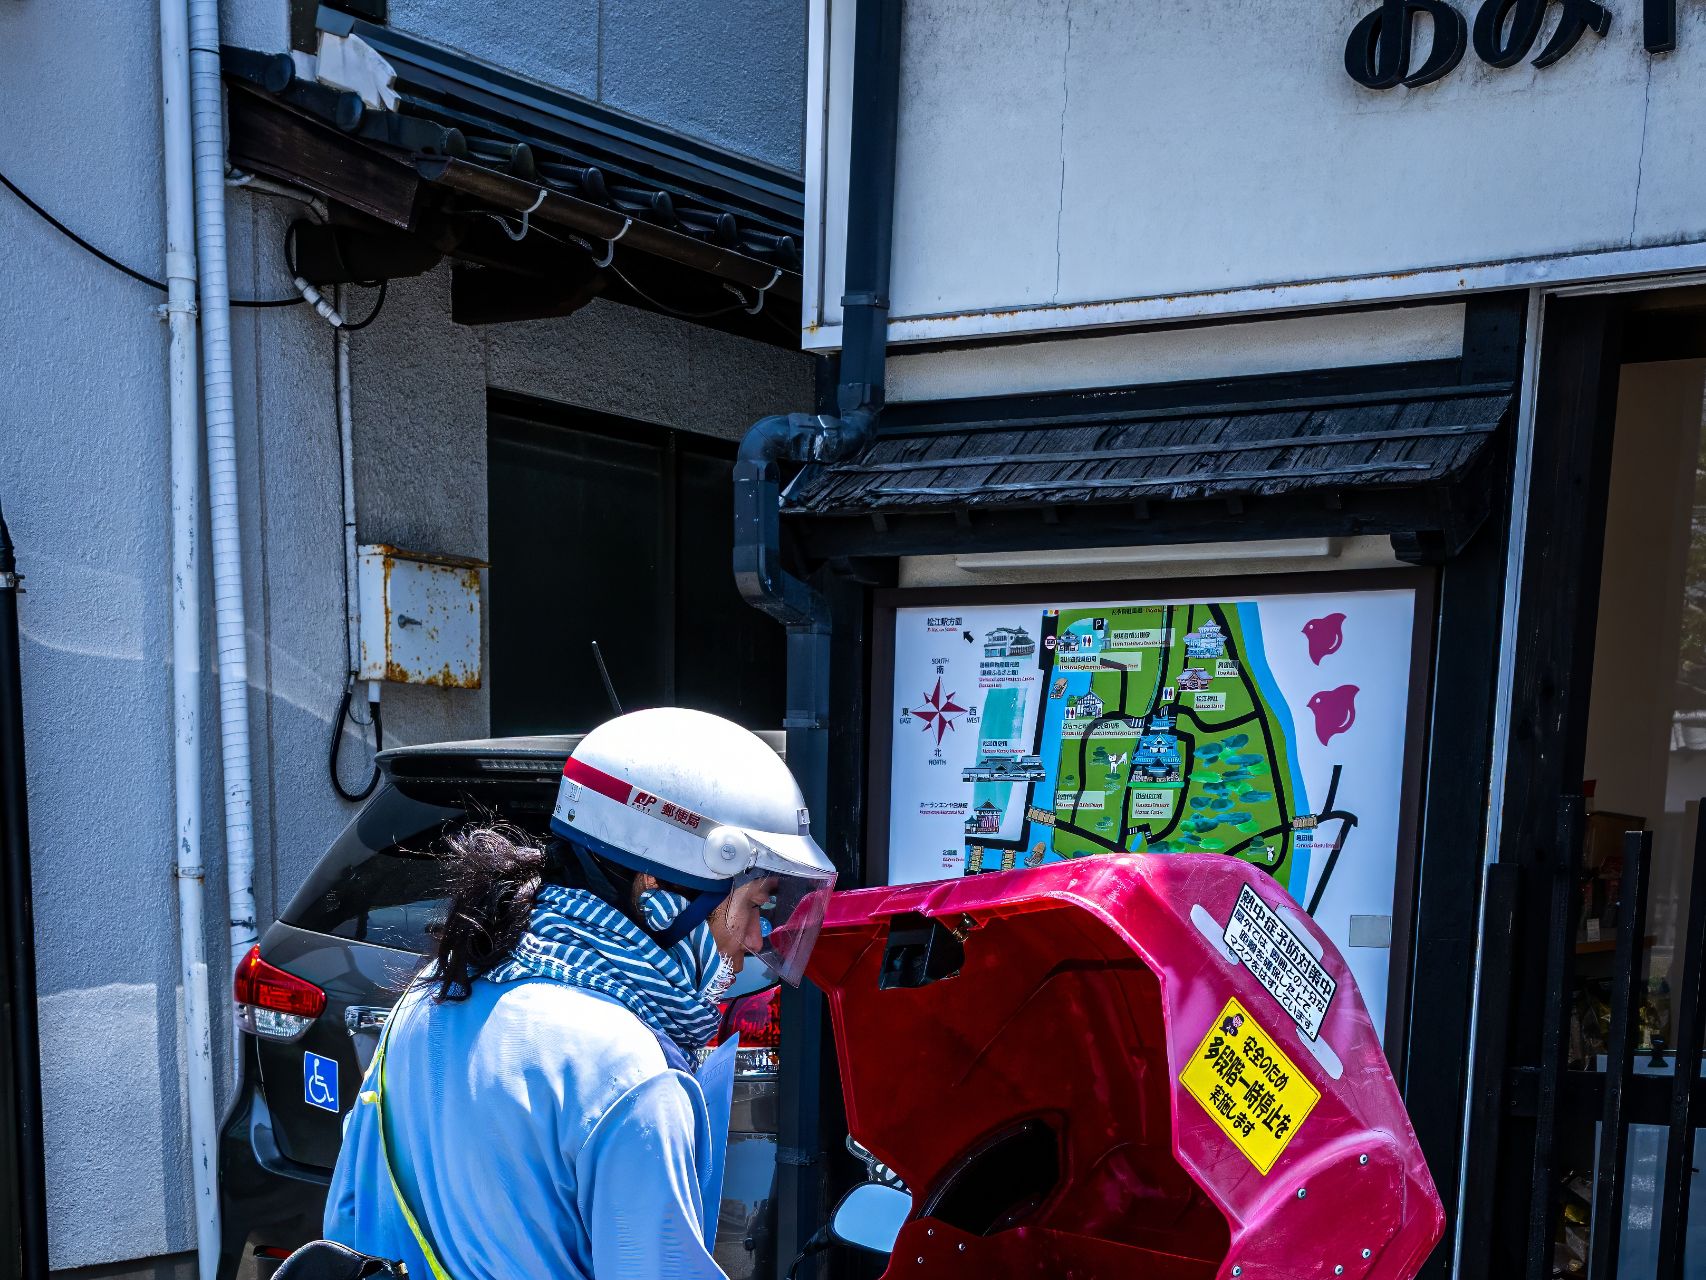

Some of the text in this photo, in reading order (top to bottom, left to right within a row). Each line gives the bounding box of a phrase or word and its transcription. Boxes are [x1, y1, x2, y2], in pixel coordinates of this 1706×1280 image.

[936, 665, 945, 675] 南
[969, 707, 977, 716] 西
[934, 748, 942, 757] 北
[661, 802, 701, 829] 郵便局
[1240, 889, 1333, 997] 熱中症予防対策中
[1242, 1036, 1289, 1092] 安全のため
[1204, 1036, 1292, 1139] 多段階一時停止を
[1209, 1084, 1256, 1138] 実施します
